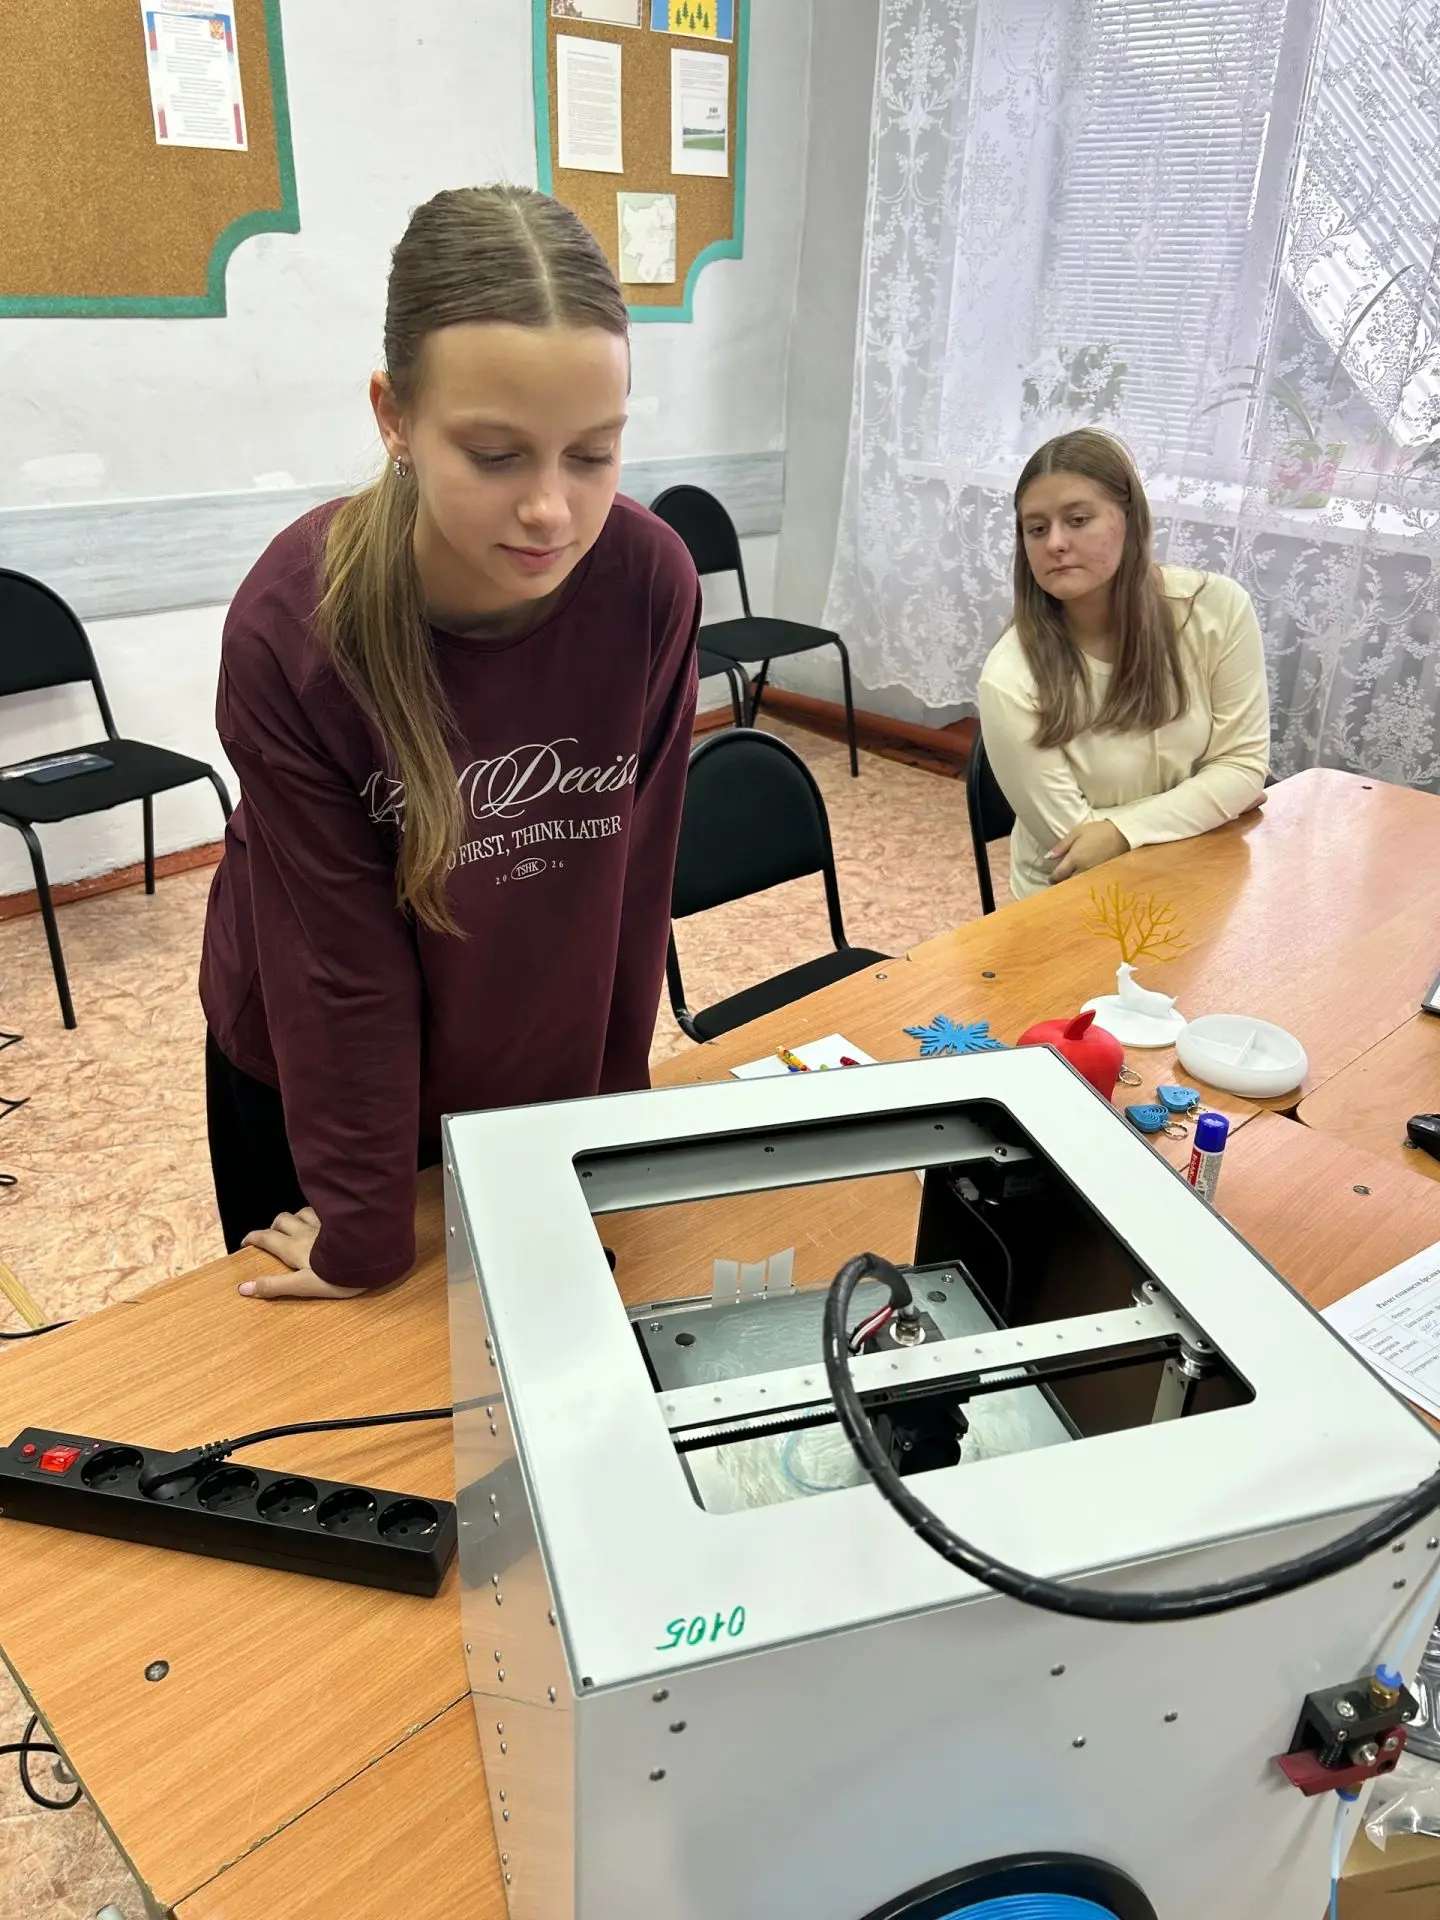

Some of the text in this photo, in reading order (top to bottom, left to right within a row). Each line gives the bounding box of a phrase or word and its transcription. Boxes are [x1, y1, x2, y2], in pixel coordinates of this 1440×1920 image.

[459, 834, 511, 867] FIRST,
[511, 820, 568, 849] THINK
[569, 815, 623, 840] LATER
[515, 860, 540, 877] TSHK
[655, 1605, 746, 1650] 0105
